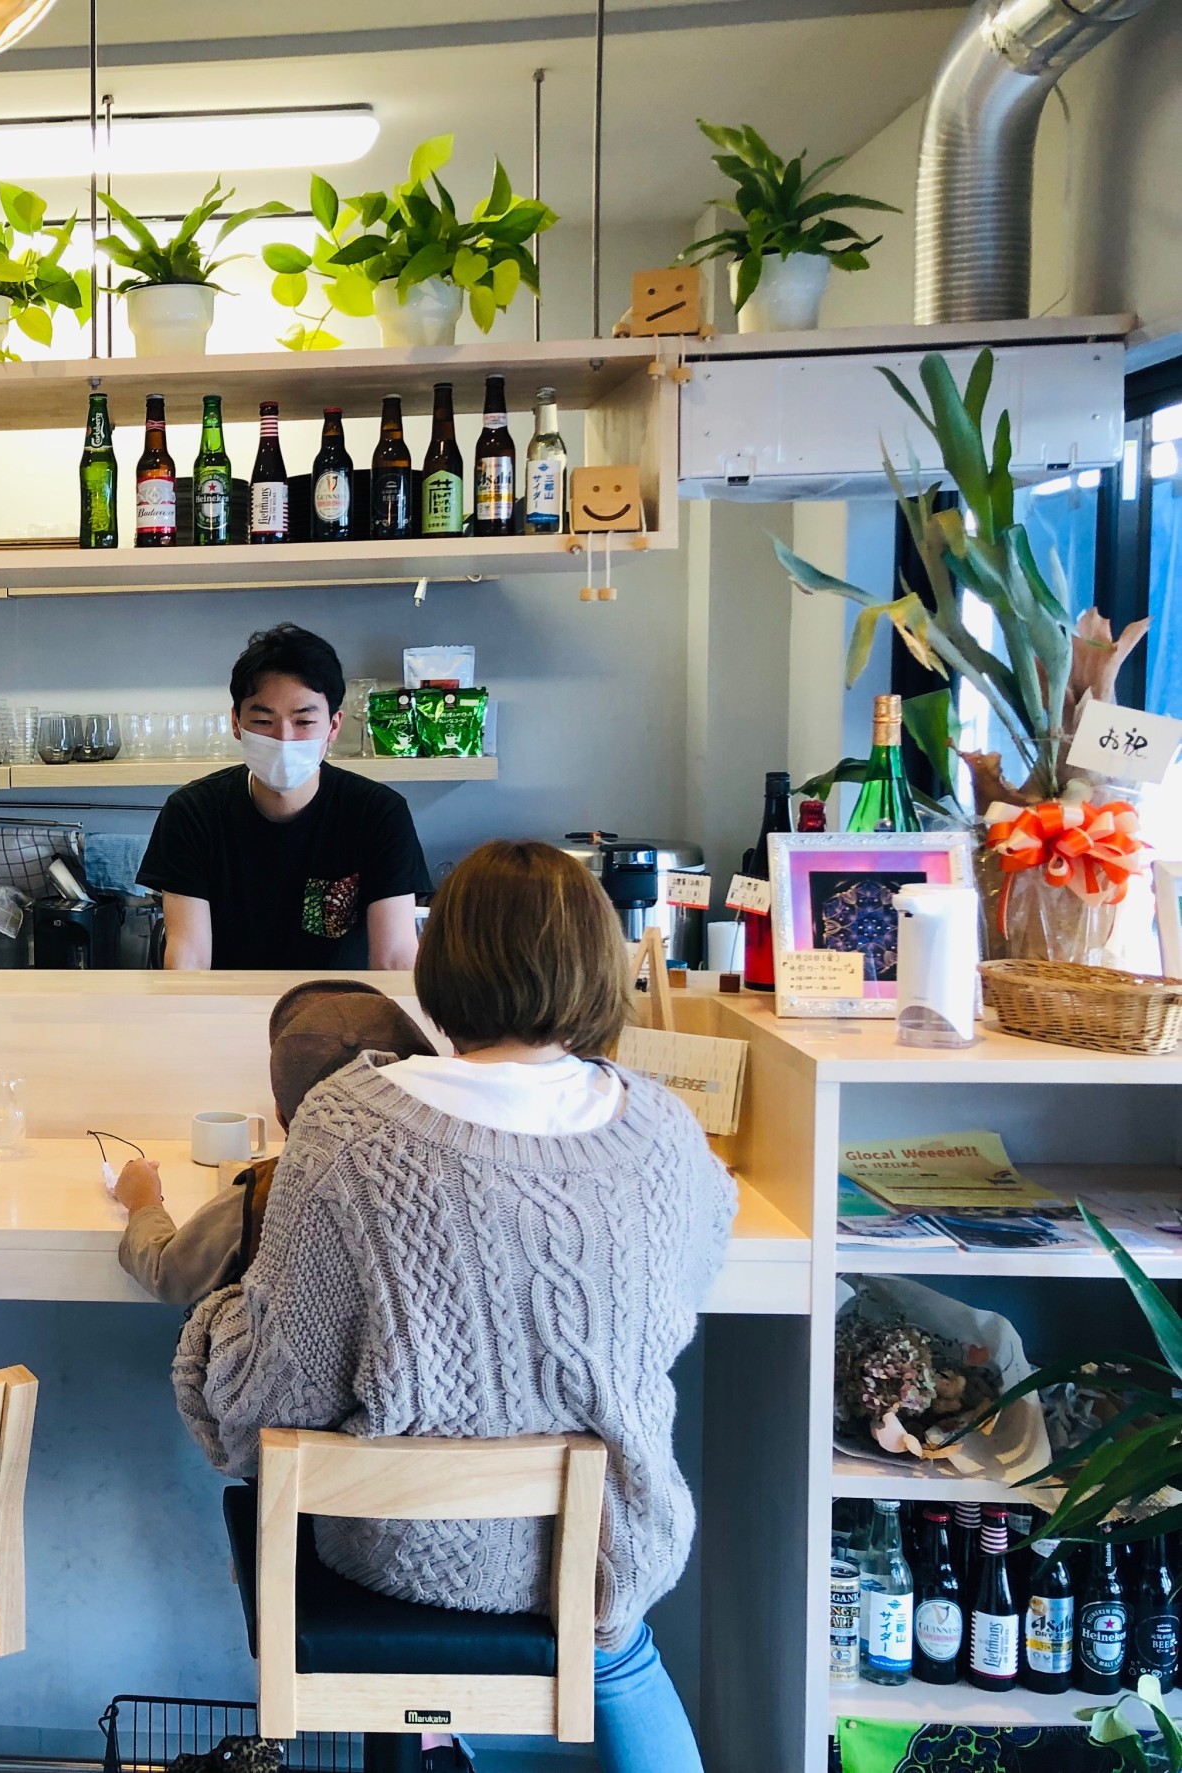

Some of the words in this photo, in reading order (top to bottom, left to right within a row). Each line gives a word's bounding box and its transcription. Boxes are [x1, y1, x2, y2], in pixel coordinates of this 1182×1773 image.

[91, 412, 105, 448] Carlsberg
[195, 494, 230, 503] Heineken
[532, 475, 542, 508] サイダー
[138, 508, 175, 518] Budweier
[258, 487, 272, 525] Liefmans
[665, 1073, 707, 1093] MERGE
[845, 1149, 896, 1161] Glocal
[873, 1161, 922, 1169] IIZUKA
[879, 1610, 893, 1652] サイダー
[1031, 1614, 1073, 1633] Asah
[983, 1622, 1004, 1668] Liefmans
